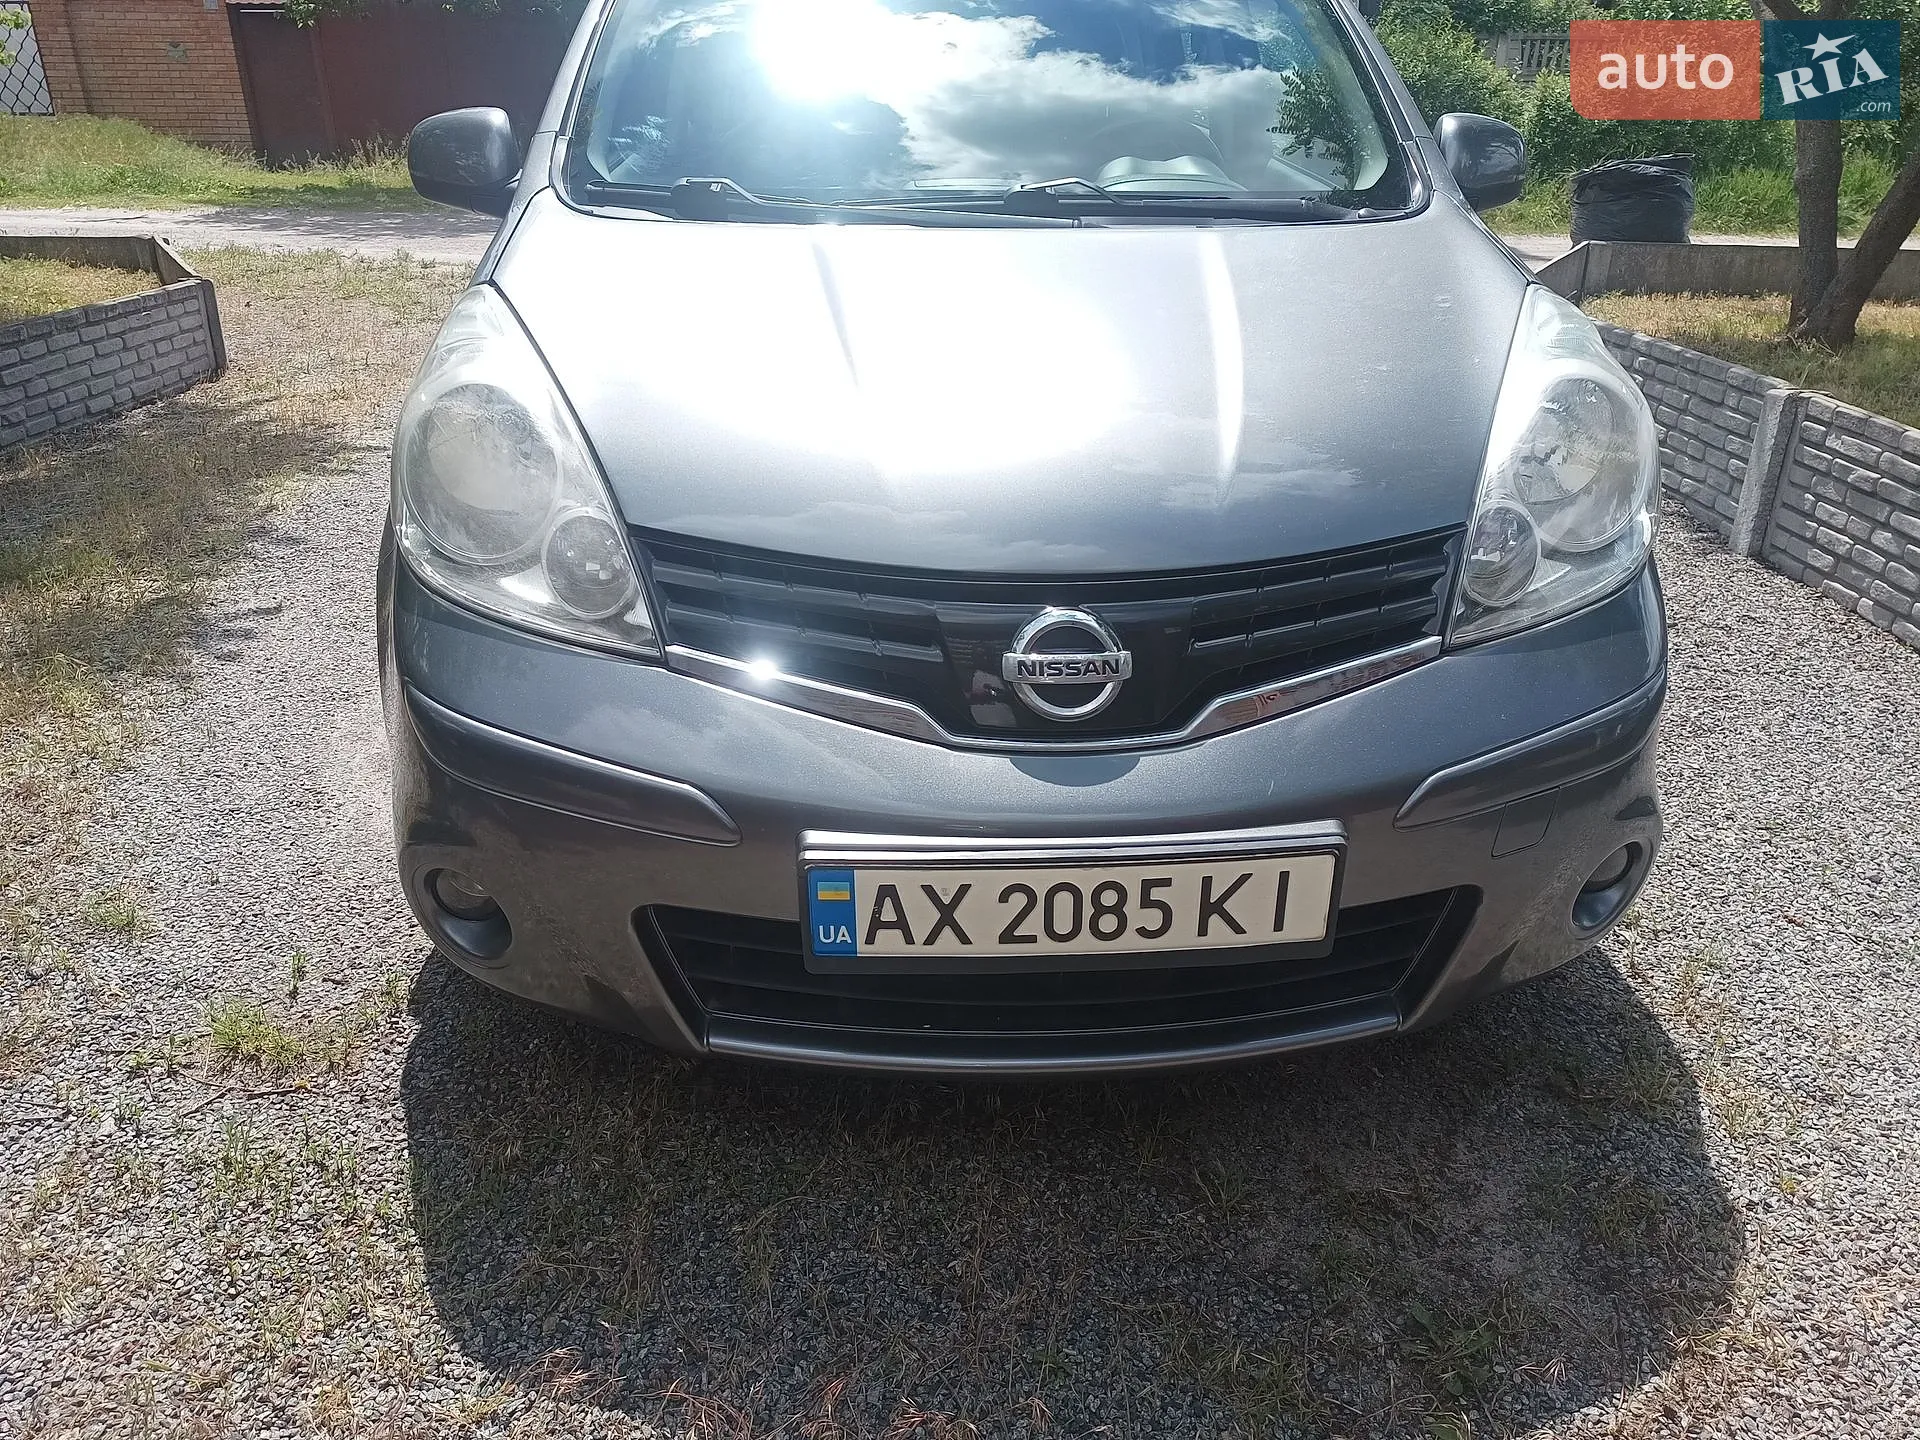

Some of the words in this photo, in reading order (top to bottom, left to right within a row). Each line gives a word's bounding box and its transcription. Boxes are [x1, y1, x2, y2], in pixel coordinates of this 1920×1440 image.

[1017, 659, 1120, 677] NISSAN
[864, 883, 973, 946] AX
[998, 877, 1174, 944] 2085
[818, 925, 852, 944] UA
